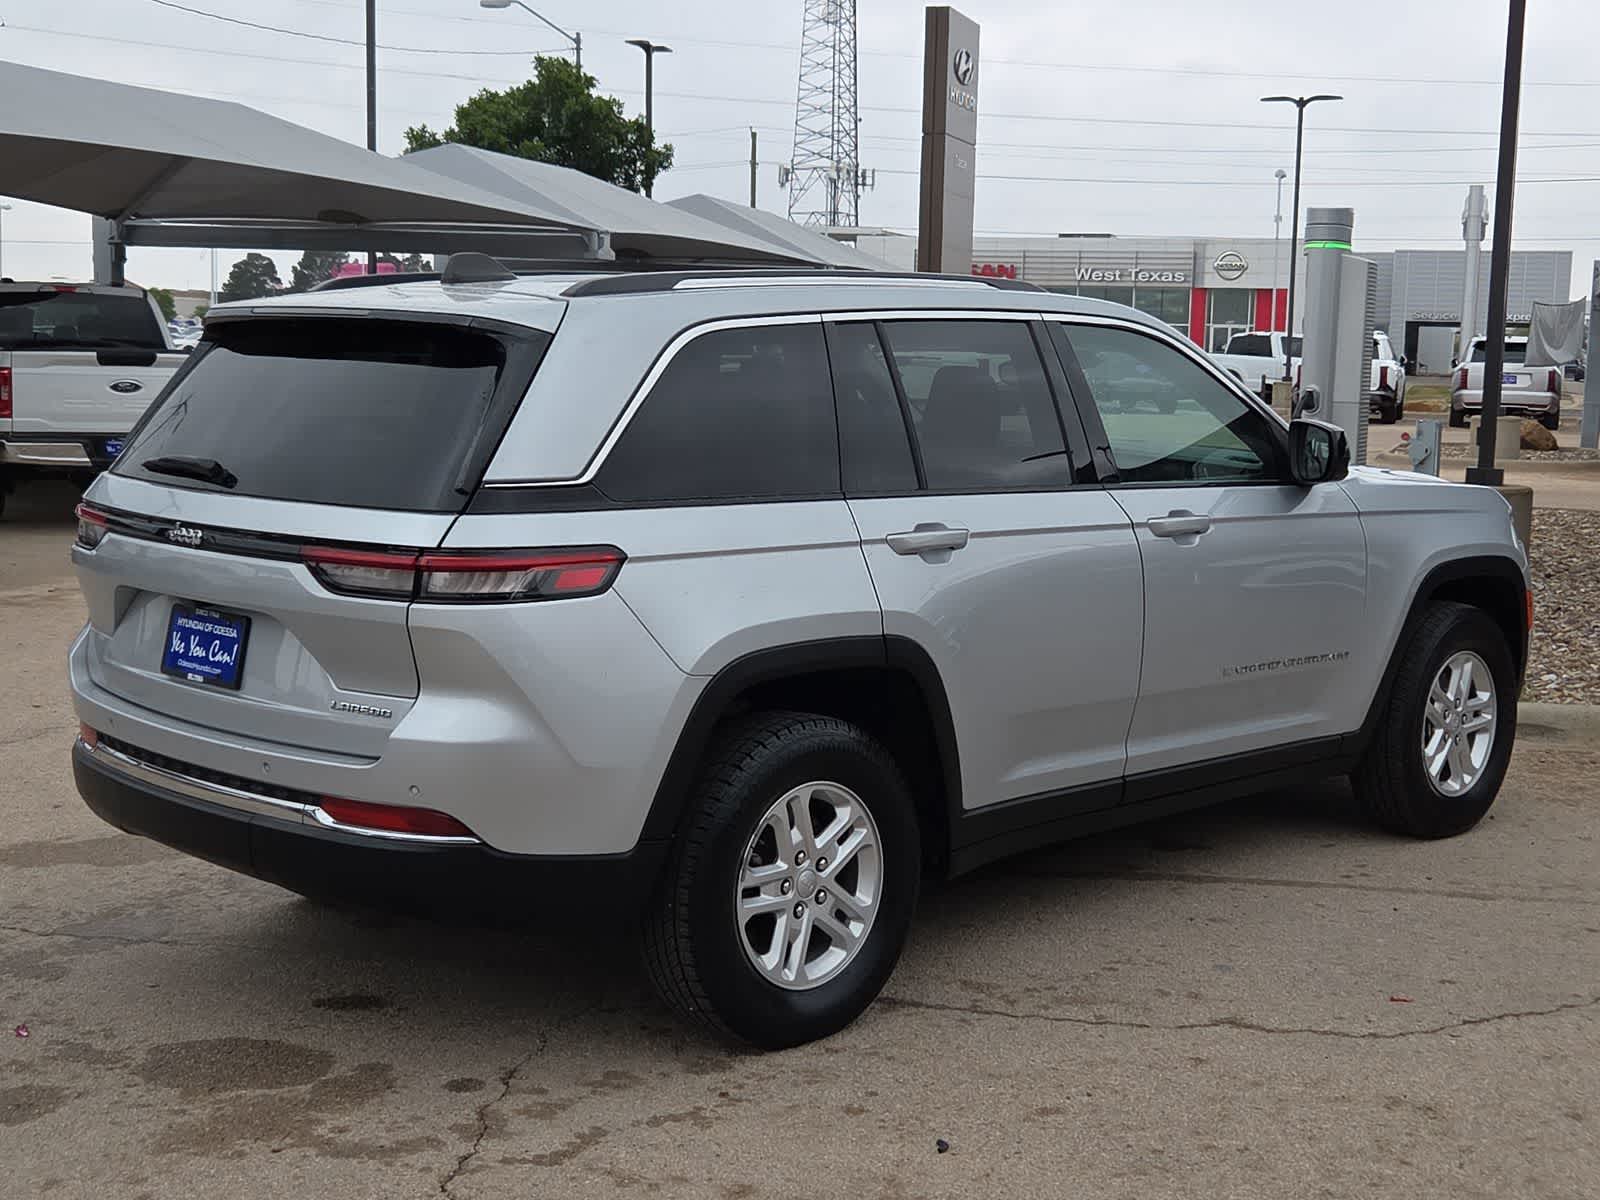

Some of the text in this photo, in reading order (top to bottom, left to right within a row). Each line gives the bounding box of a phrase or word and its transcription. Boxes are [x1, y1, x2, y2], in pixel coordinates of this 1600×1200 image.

[1074, 267, 1185, 282] West Texas
[204, 623, 213, 632] OF
[170, 631, 185, 654] Yes
[188, 635, 206, 657] You
[209, 640, 238, 666] Can!
